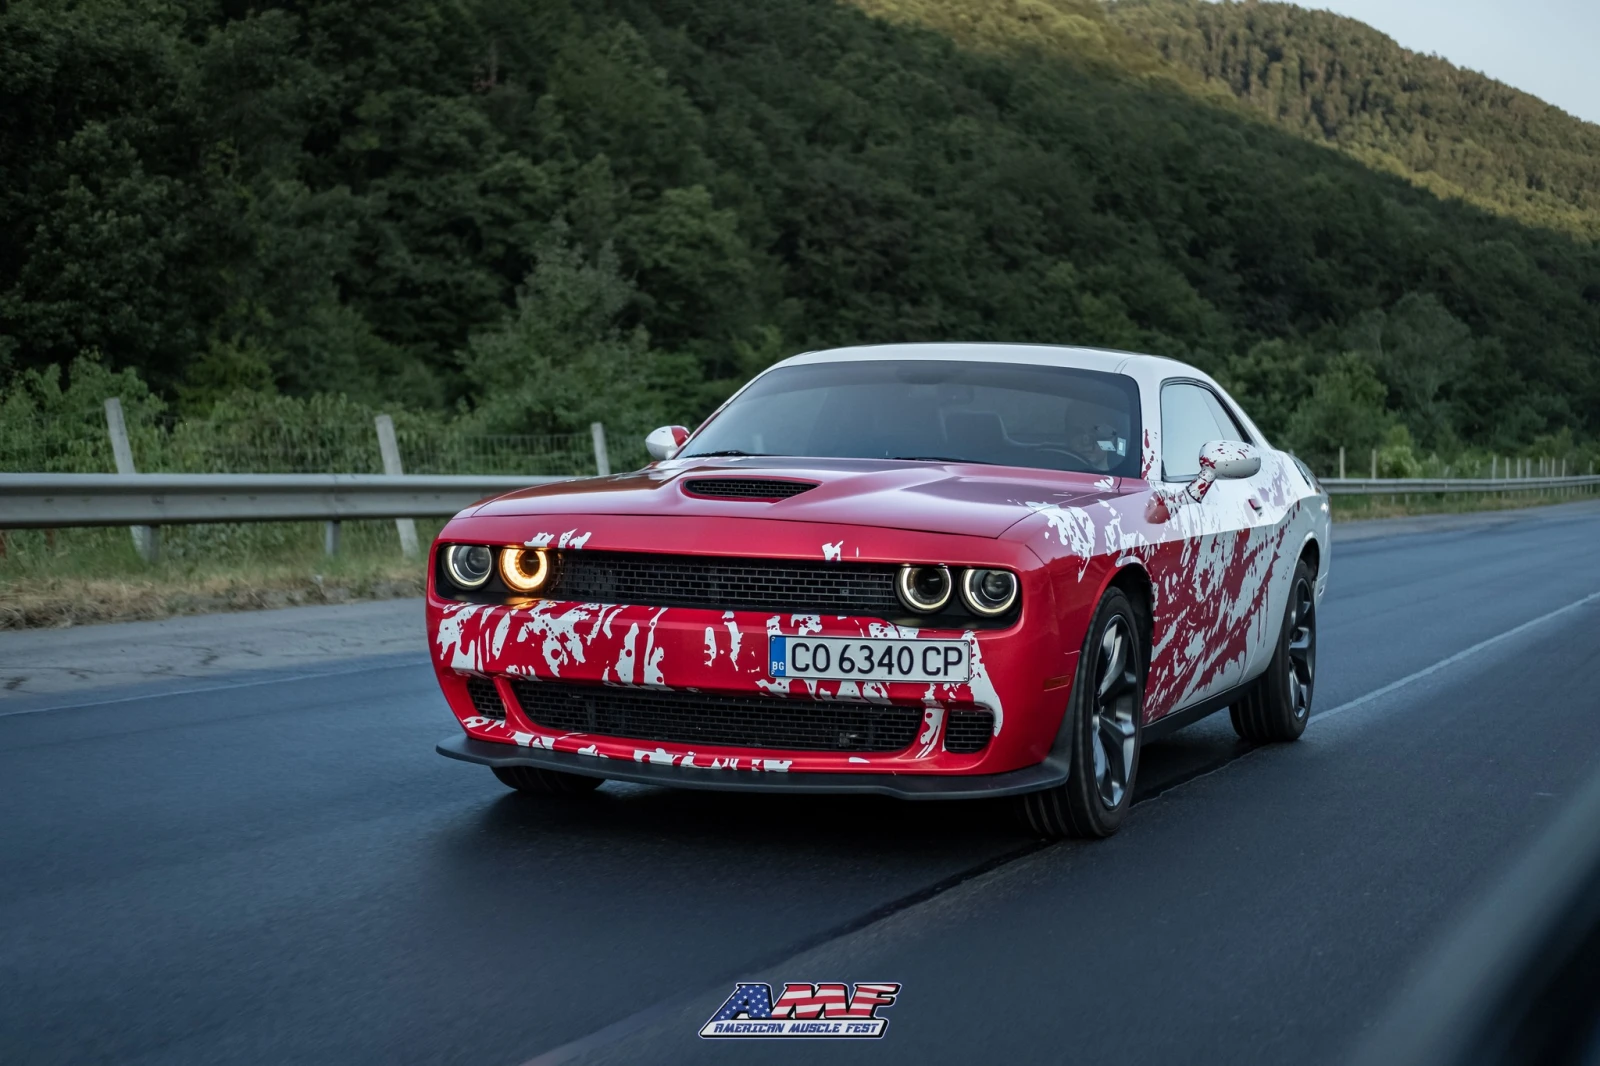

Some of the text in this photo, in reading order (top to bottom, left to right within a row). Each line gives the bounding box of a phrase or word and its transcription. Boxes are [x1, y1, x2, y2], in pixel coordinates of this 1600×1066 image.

[772, 661, 785, 671] BG
[791, 642, 963, 676] CO 6340 CP
